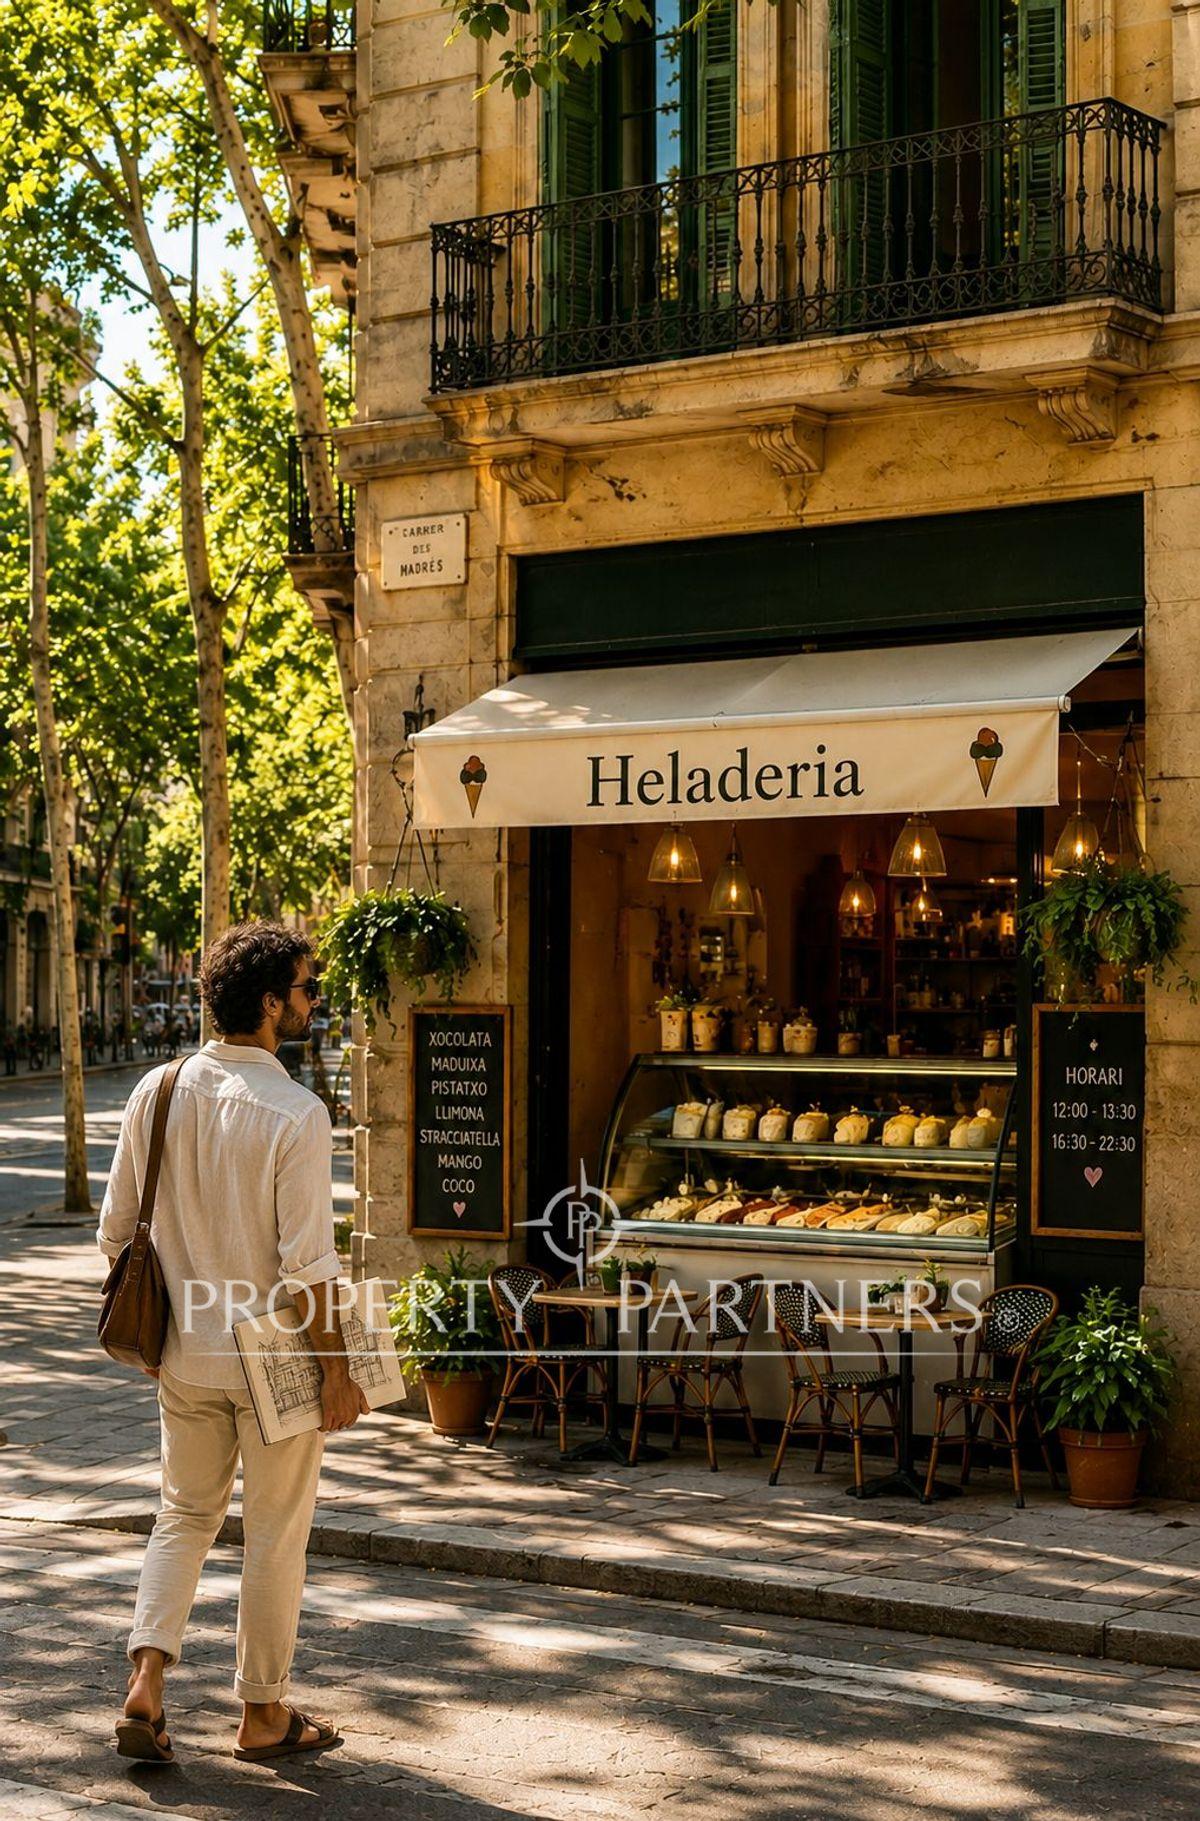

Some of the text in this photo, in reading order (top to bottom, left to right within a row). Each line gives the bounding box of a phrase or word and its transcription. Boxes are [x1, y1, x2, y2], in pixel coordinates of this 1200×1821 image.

[412, 543, 431, 555] DES
[586, 744, 864, 807] Heladeria
[428, 1031, 492, 1048] XOCOLATA
[431, 1056, 487, 1072] MADUIXA
[1066, 1066, 1123, 1086] HORARI
[431, 1080, 488, 1097] PISTATXO
[435, 1104, 485, 1121] LLIMONA
[1052, 1101, 1088, 1119] 12:00
[1102, 1103, 1137, 1120] 13:30
[419, 1129, 501, 1147] STRACCIATELLA
[1052, 1133, 1087, 1150] 16:30
[1098, 1135, 1136, 1152] 22:30
[437, 1154, 482, 1170] MANGO
[441, 1178, 475, 1194] COCO
